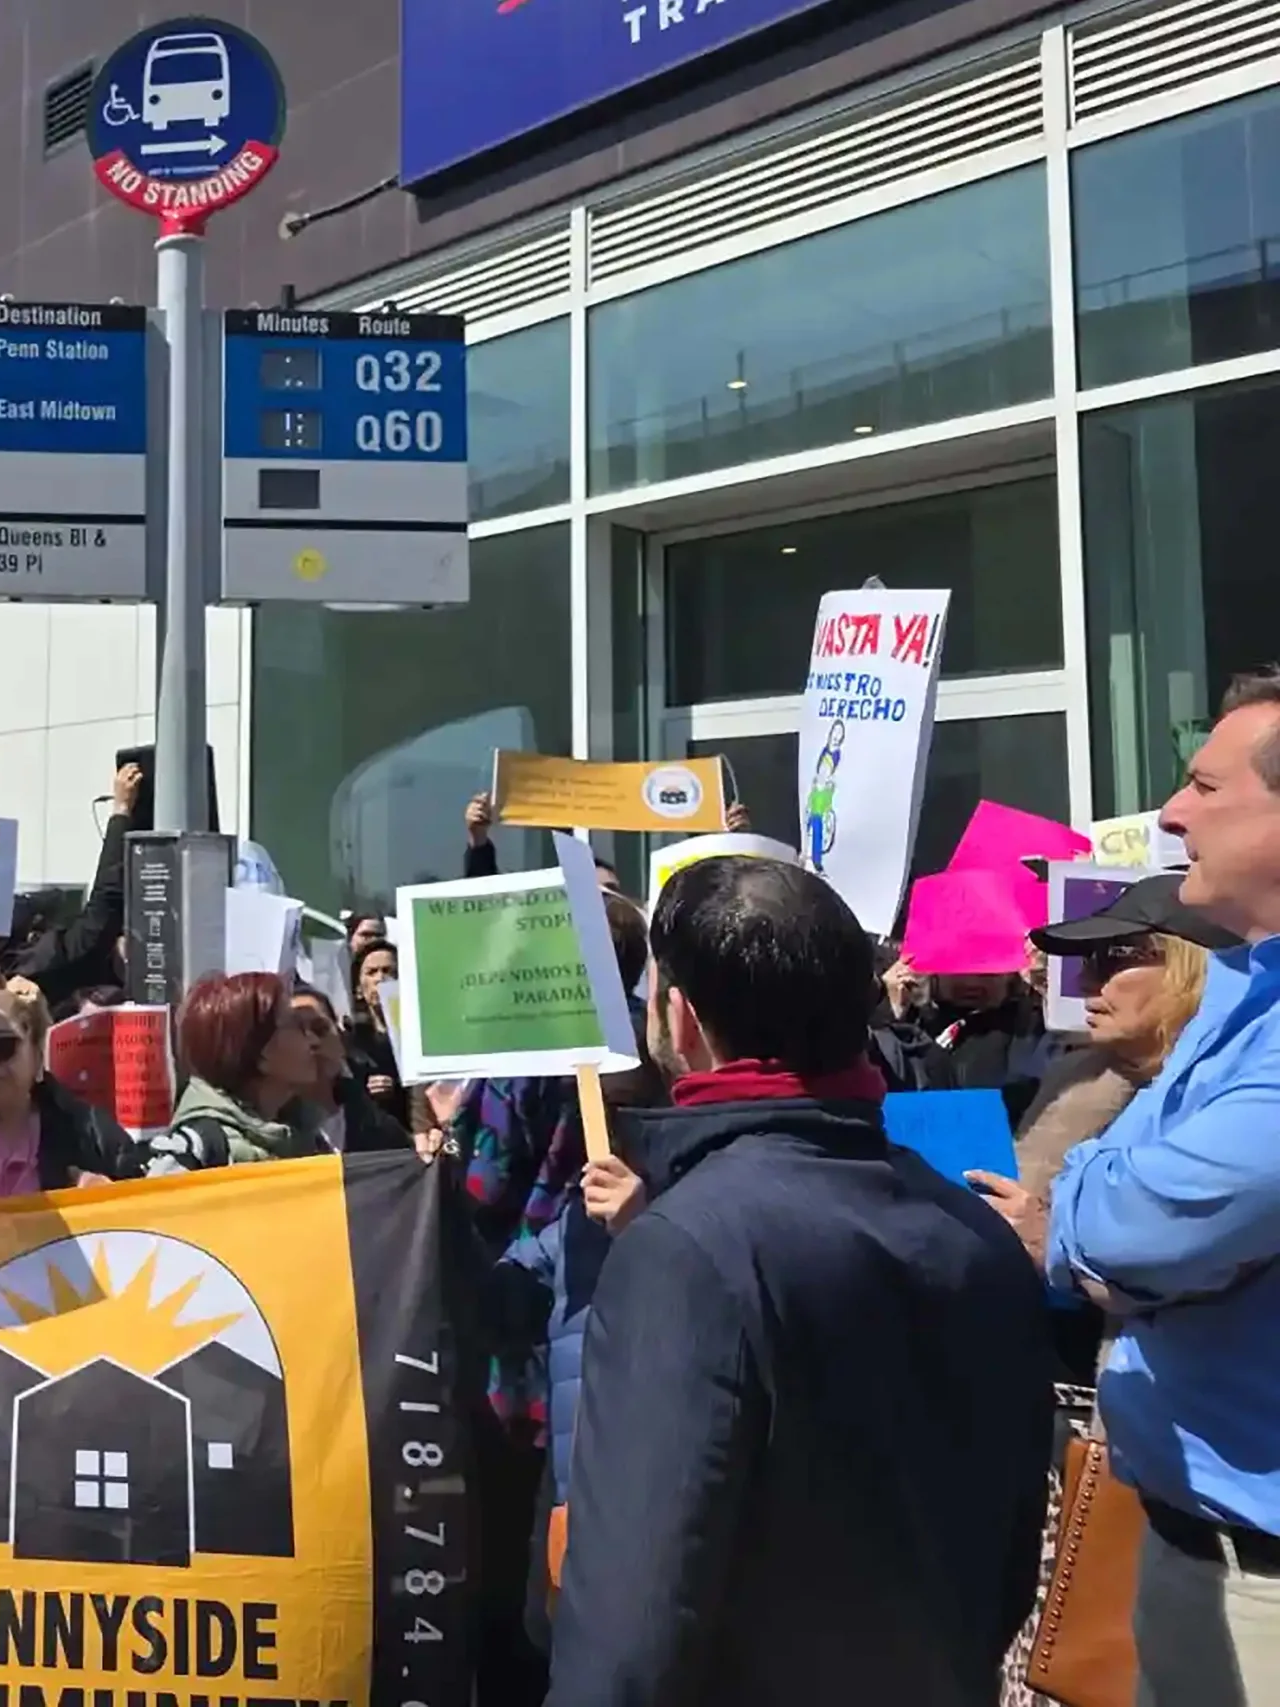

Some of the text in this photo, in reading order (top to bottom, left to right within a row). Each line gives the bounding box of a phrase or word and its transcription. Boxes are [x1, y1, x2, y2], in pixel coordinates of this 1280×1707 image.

[106, 150, 265, 208] NO STANDING
[257, 313, 411, 336] Minutes Route
[46, 340, 109, 361] Station
[356, 351, 443, 393] Q32
[40, 400, 117, 421] Midtown
[356, 411, 443, 453] Q60
[70, 528, 88, 548] Bl
[94, 530, 107, 548] &
[25, 553, 43, 574] Pl
[890, 612, 940, 668] YA!
[819, 697, 906, 722] DERECHO
[394, 1350, 445, 1707] 718.784.
